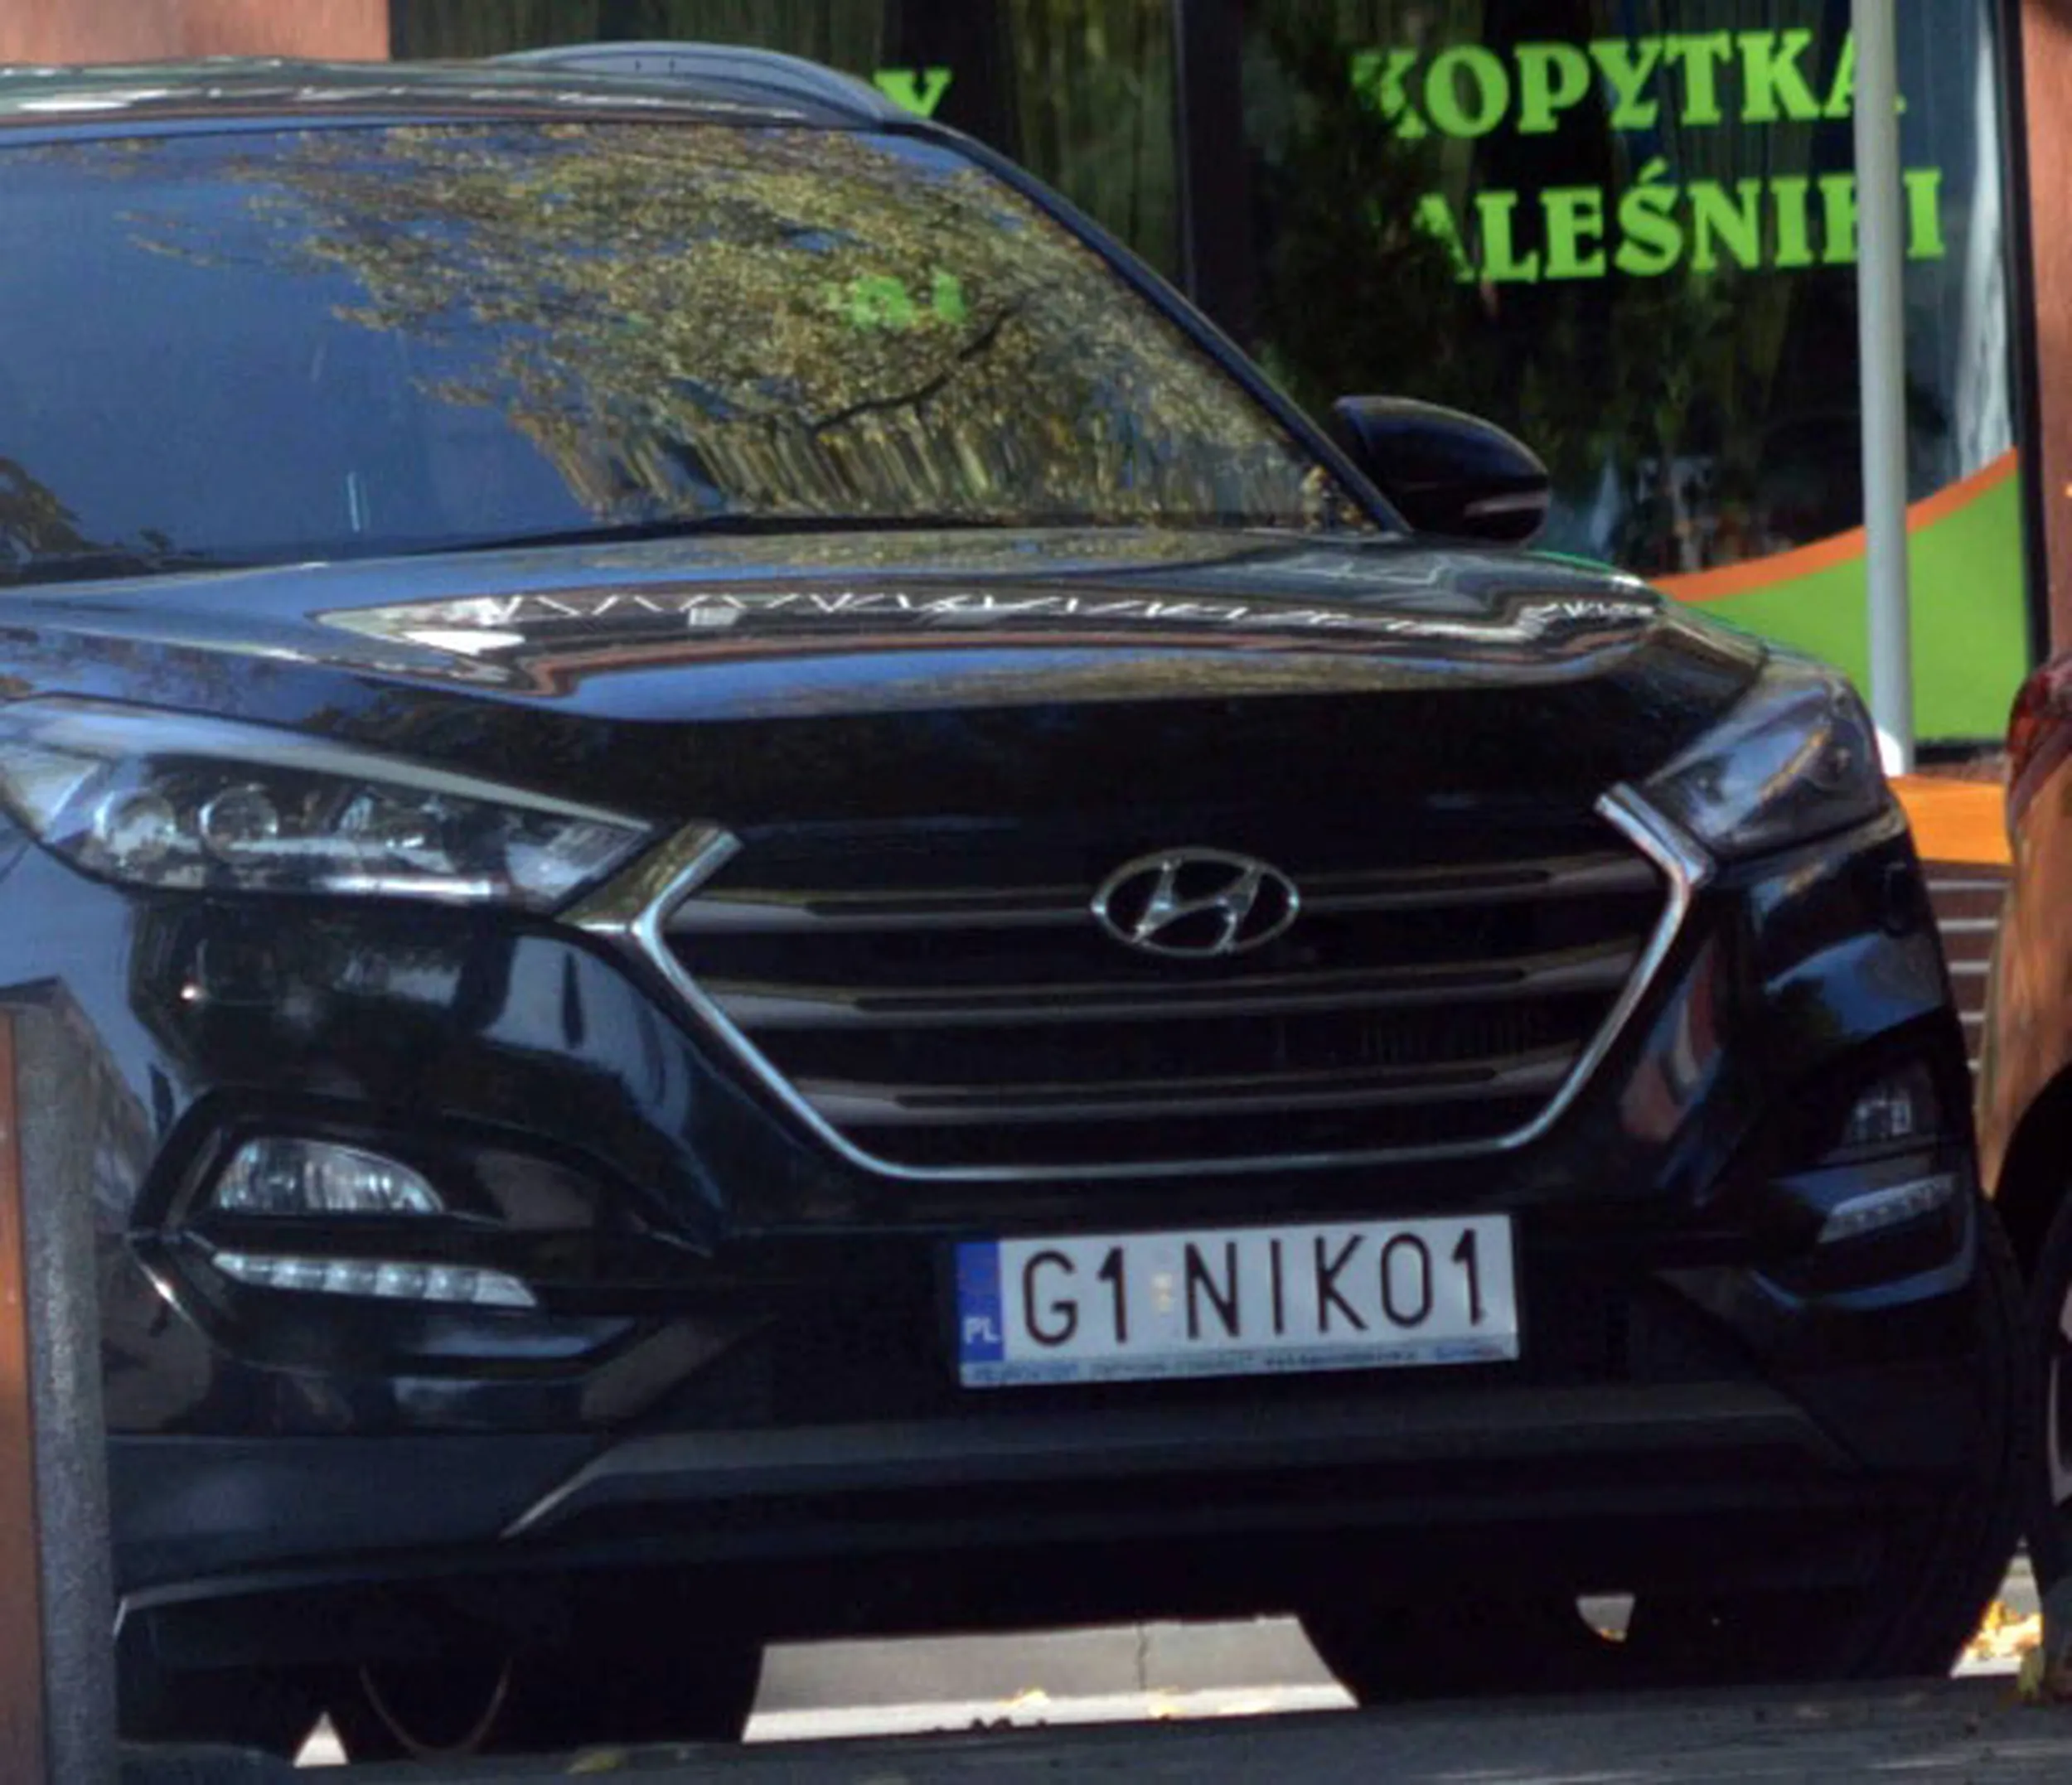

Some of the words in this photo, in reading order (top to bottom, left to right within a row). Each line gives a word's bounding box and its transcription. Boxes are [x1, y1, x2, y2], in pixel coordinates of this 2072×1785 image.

[1411, 157, 1945, 283] ALEŚNII
[964, 1317, 1001, 1344] PL
[1021, 1246, 1127, 1348] G1
